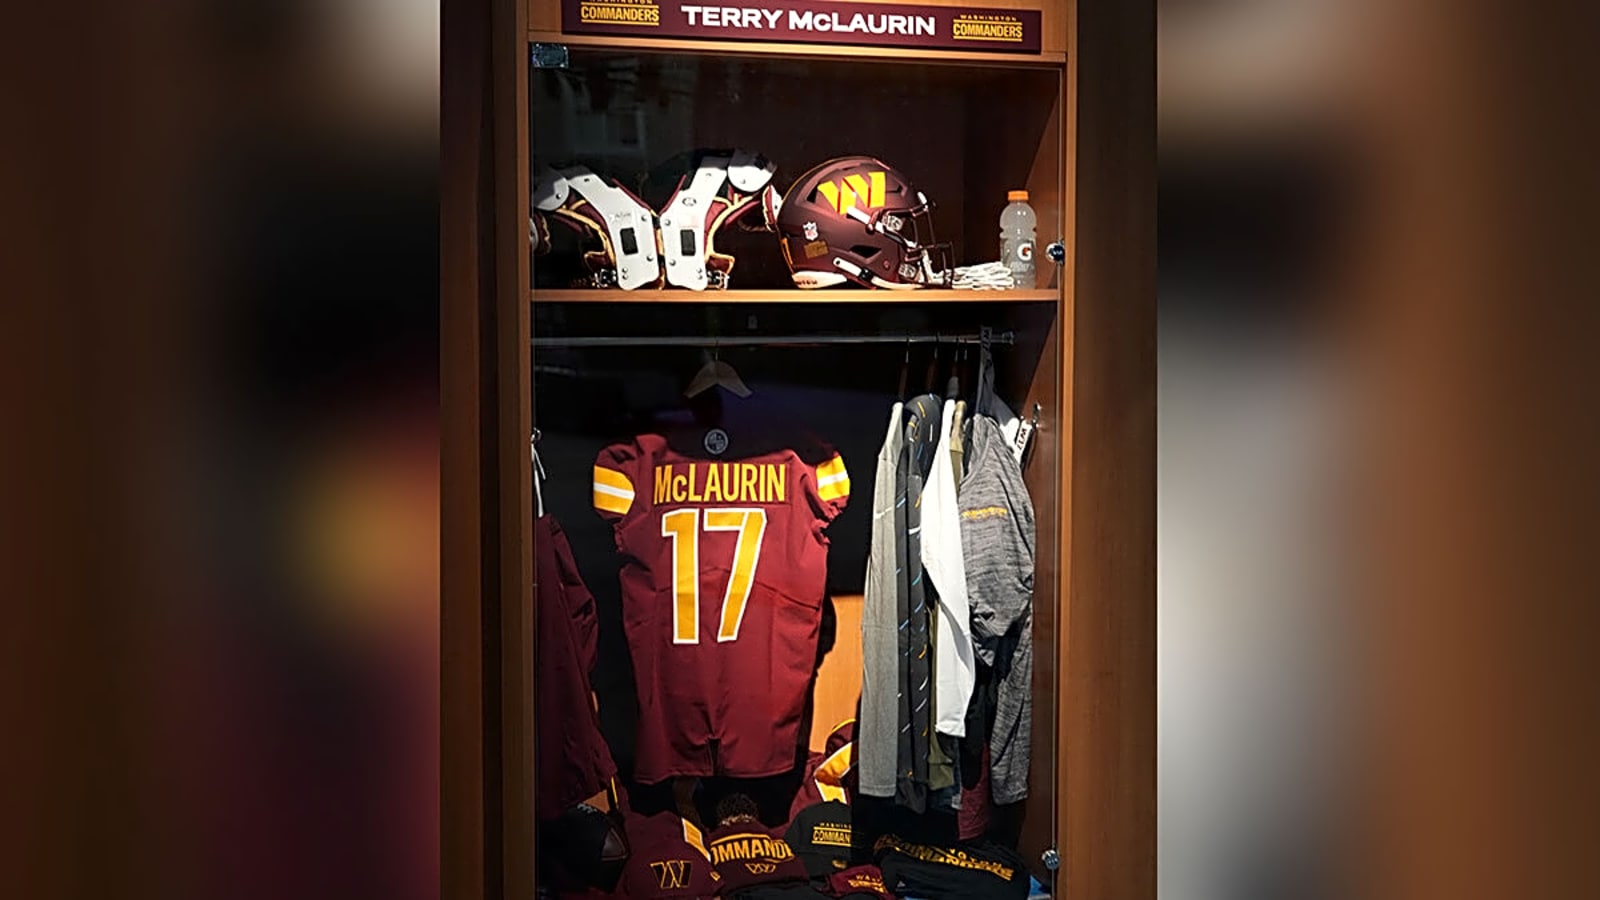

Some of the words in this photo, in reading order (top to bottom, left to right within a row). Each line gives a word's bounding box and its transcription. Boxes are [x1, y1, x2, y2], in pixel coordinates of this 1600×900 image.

[580, 6, 660, 22] COMMANDERS
[681, 5, 783, 29] TERRY
[953, 23, 1023, 38] COMMANDERS
[1017, 242, 1032, 261] G
[653, 463, 785, 505] McLAURIN
[661, 507, 768, 645] 17
